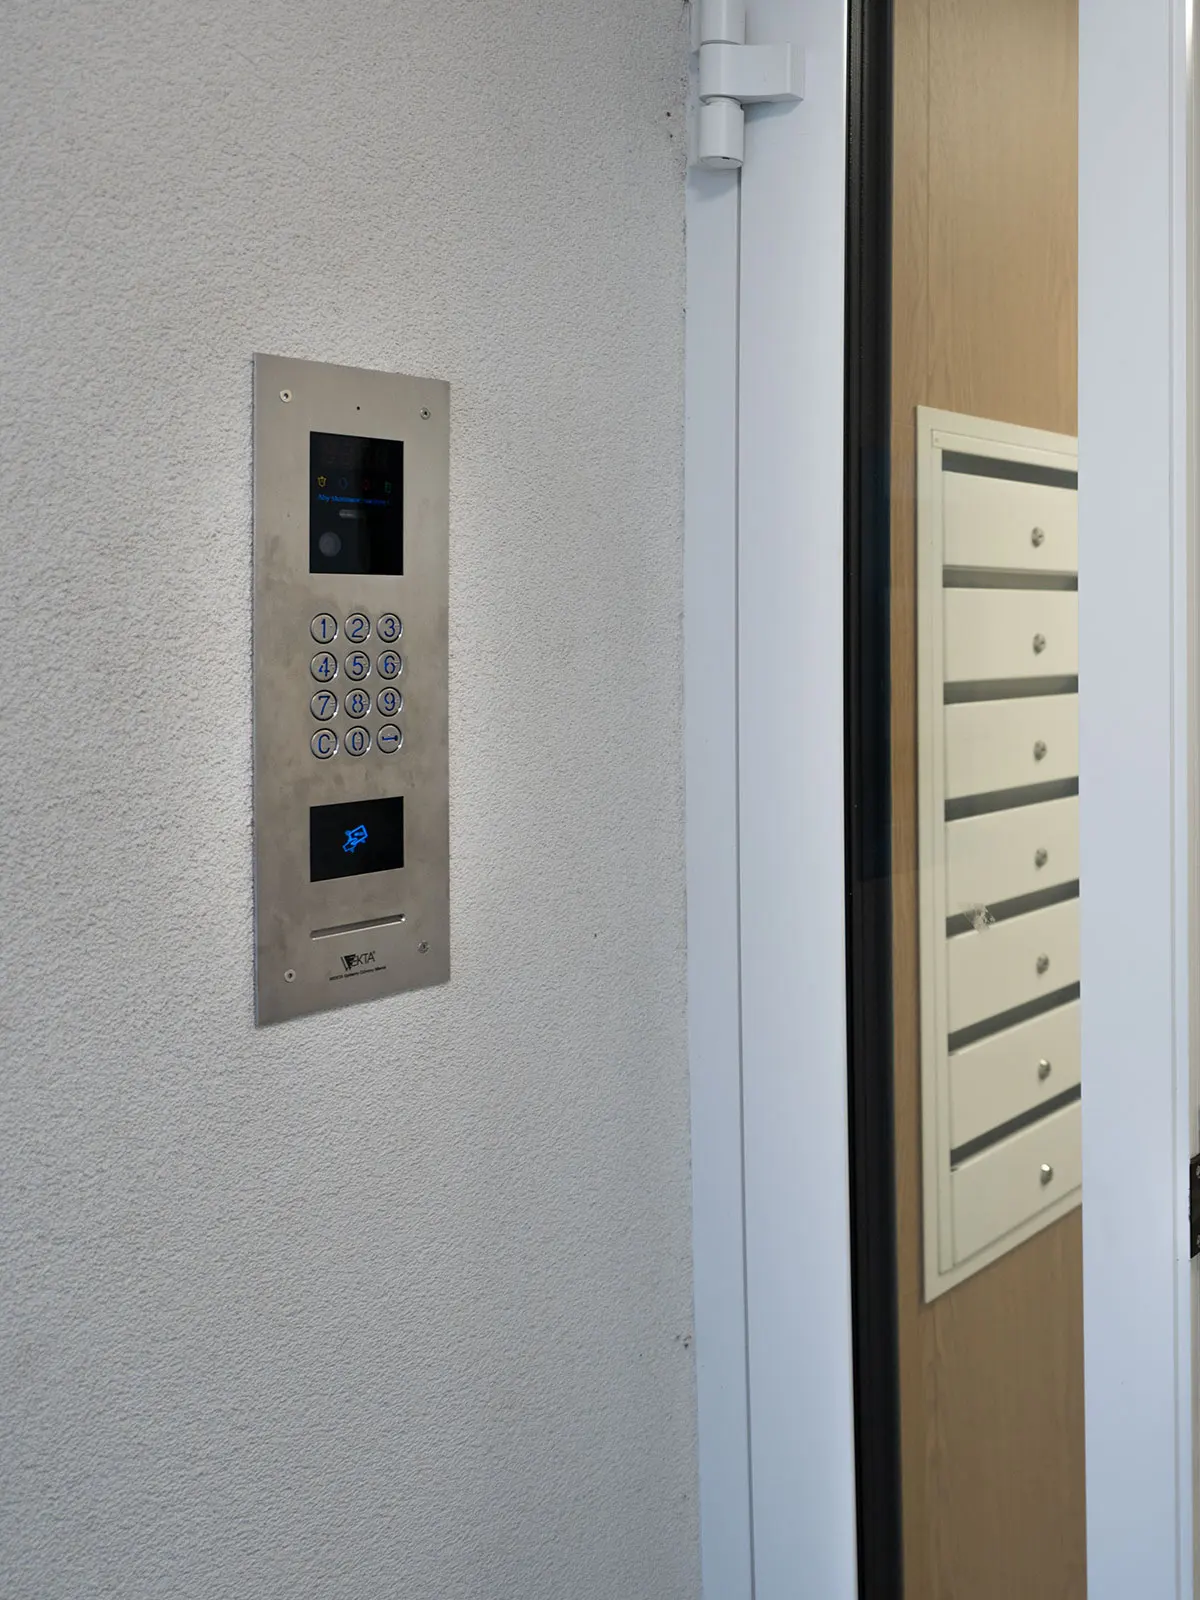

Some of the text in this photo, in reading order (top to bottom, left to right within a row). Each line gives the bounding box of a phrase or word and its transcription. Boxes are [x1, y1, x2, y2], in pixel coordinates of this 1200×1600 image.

[351, 618, 364, 638] 2
[384, 618, 396, 638] 3
[318, 655, 396, 677] 4 5 6
[318, 692, 395, 716] 7 8 9
[317, 731, 364, 754] C 0
